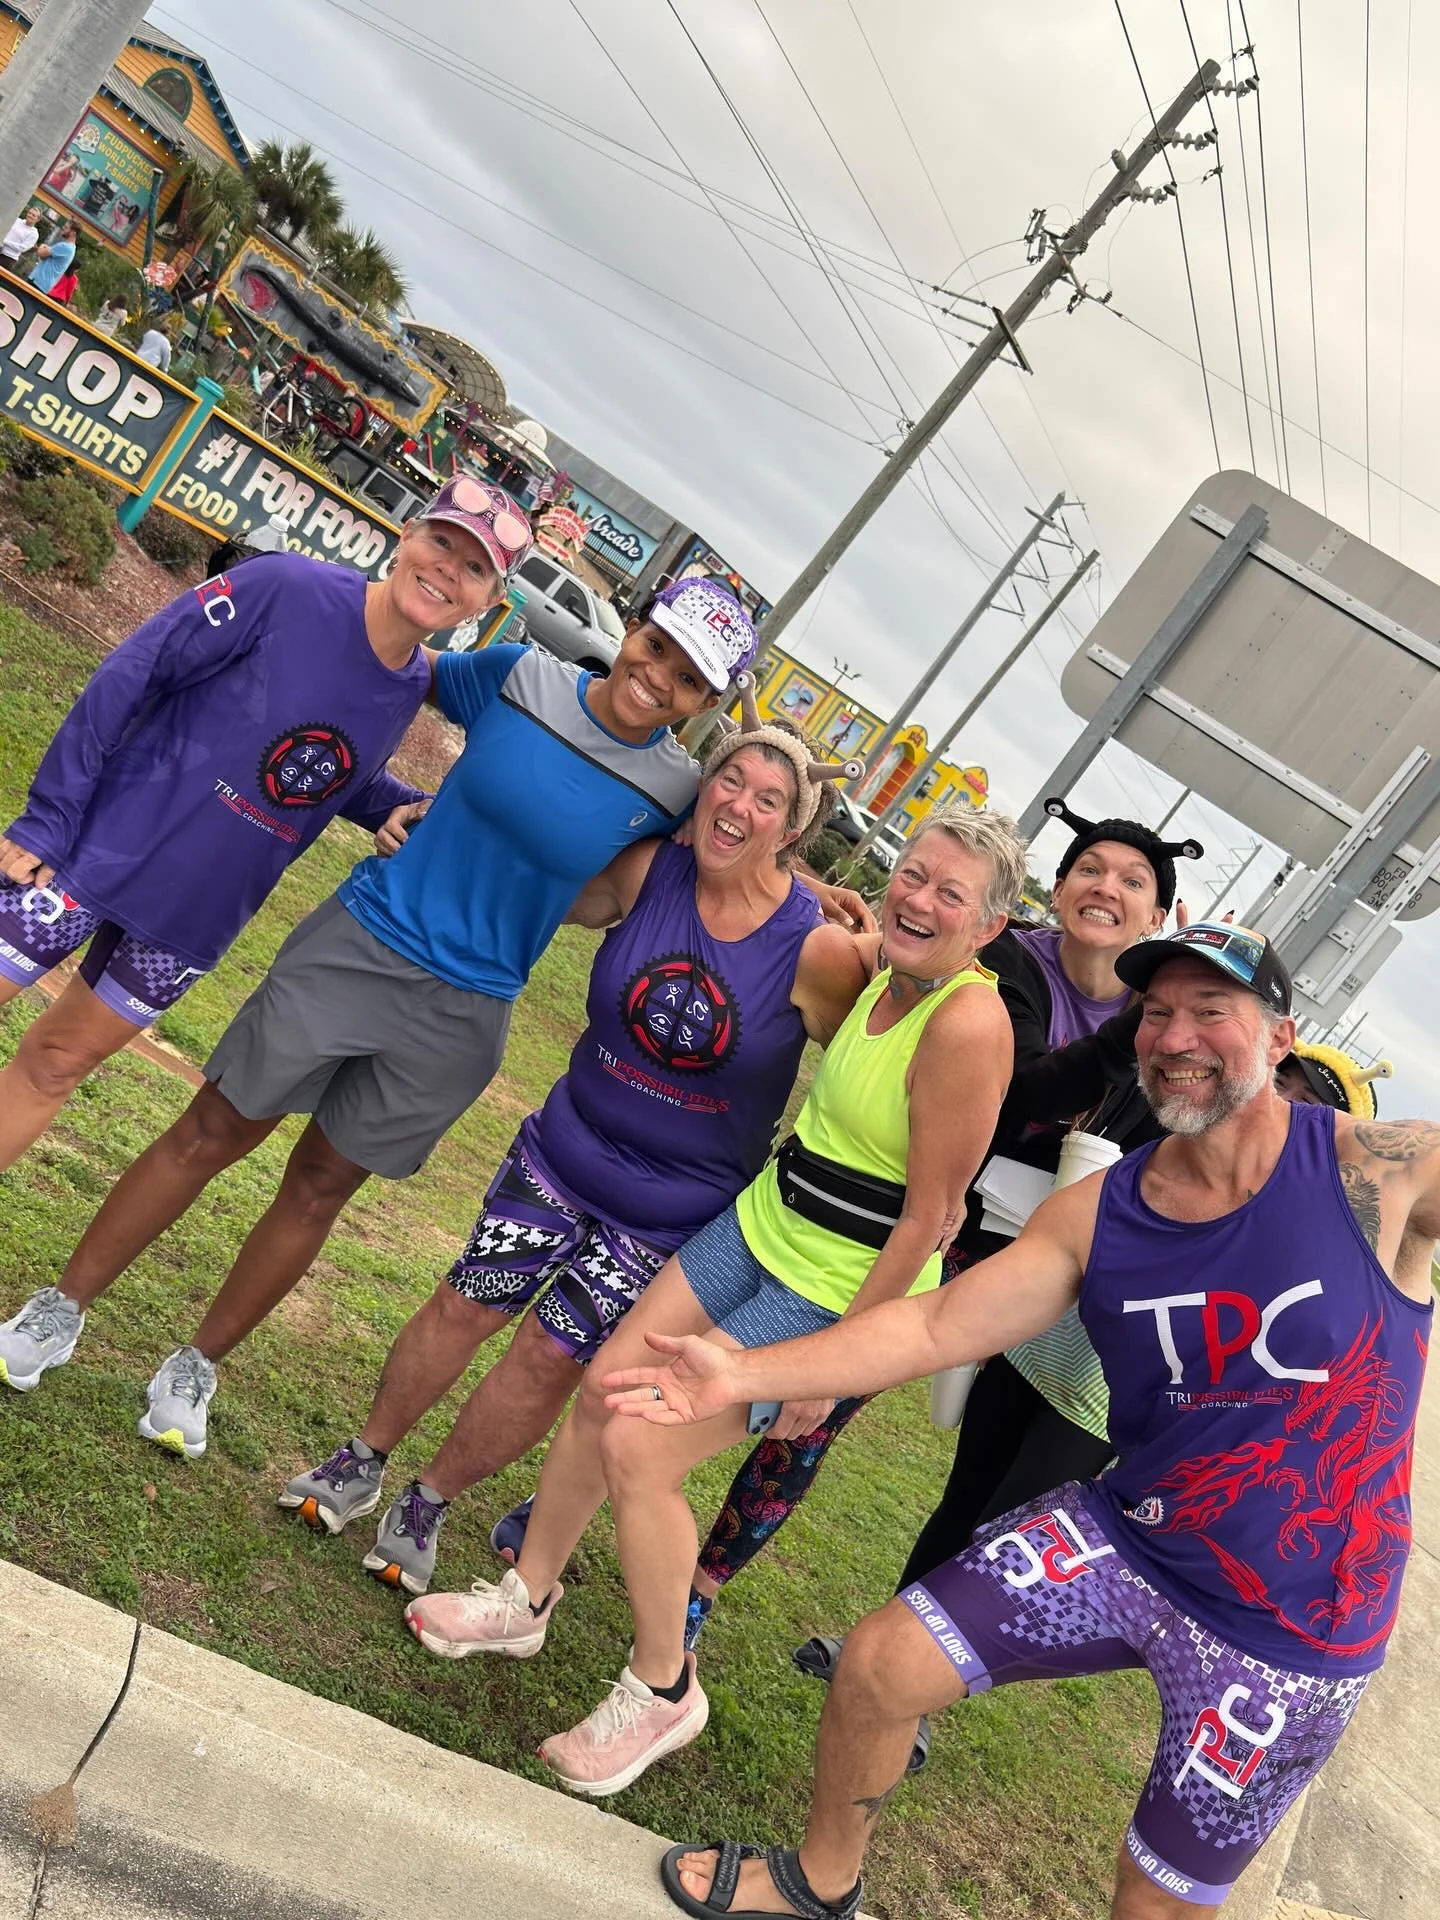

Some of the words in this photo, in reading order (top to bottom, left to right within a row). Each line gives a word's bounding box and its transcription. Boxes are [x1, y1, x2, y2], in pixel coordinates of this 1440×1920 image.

[98, 142, 126, 168] WORLD
[126, 164, 153, 191] FAMOU
[5, 375, 148, 476] T-SHIRTS
[166, 473, 238, 527] FOOD
[195, 433, 252, 487] #1
[241, 457, 316, 528] FOR
[302, 497, 387, 568] FOOD
[703, 601, 736, 643] TPC
[13, 952, 38, 972] SHUT
[630, 1080, 682, 1107] COACHING
[1123, 1279, 1329, 1384] TPC
[984, 1508, 1117, 1589] TPC
[907, 1590, 935, 1615] LEGS
[925, 1614, 948, 1632] UP
[937, 1632, 973, 1665] SHUT
[1172, 1683, 1287, 1799] TPC
[1139, 1854, 1158, 1873] UP
[1154, 1868, 1193, 1894] SHUT
